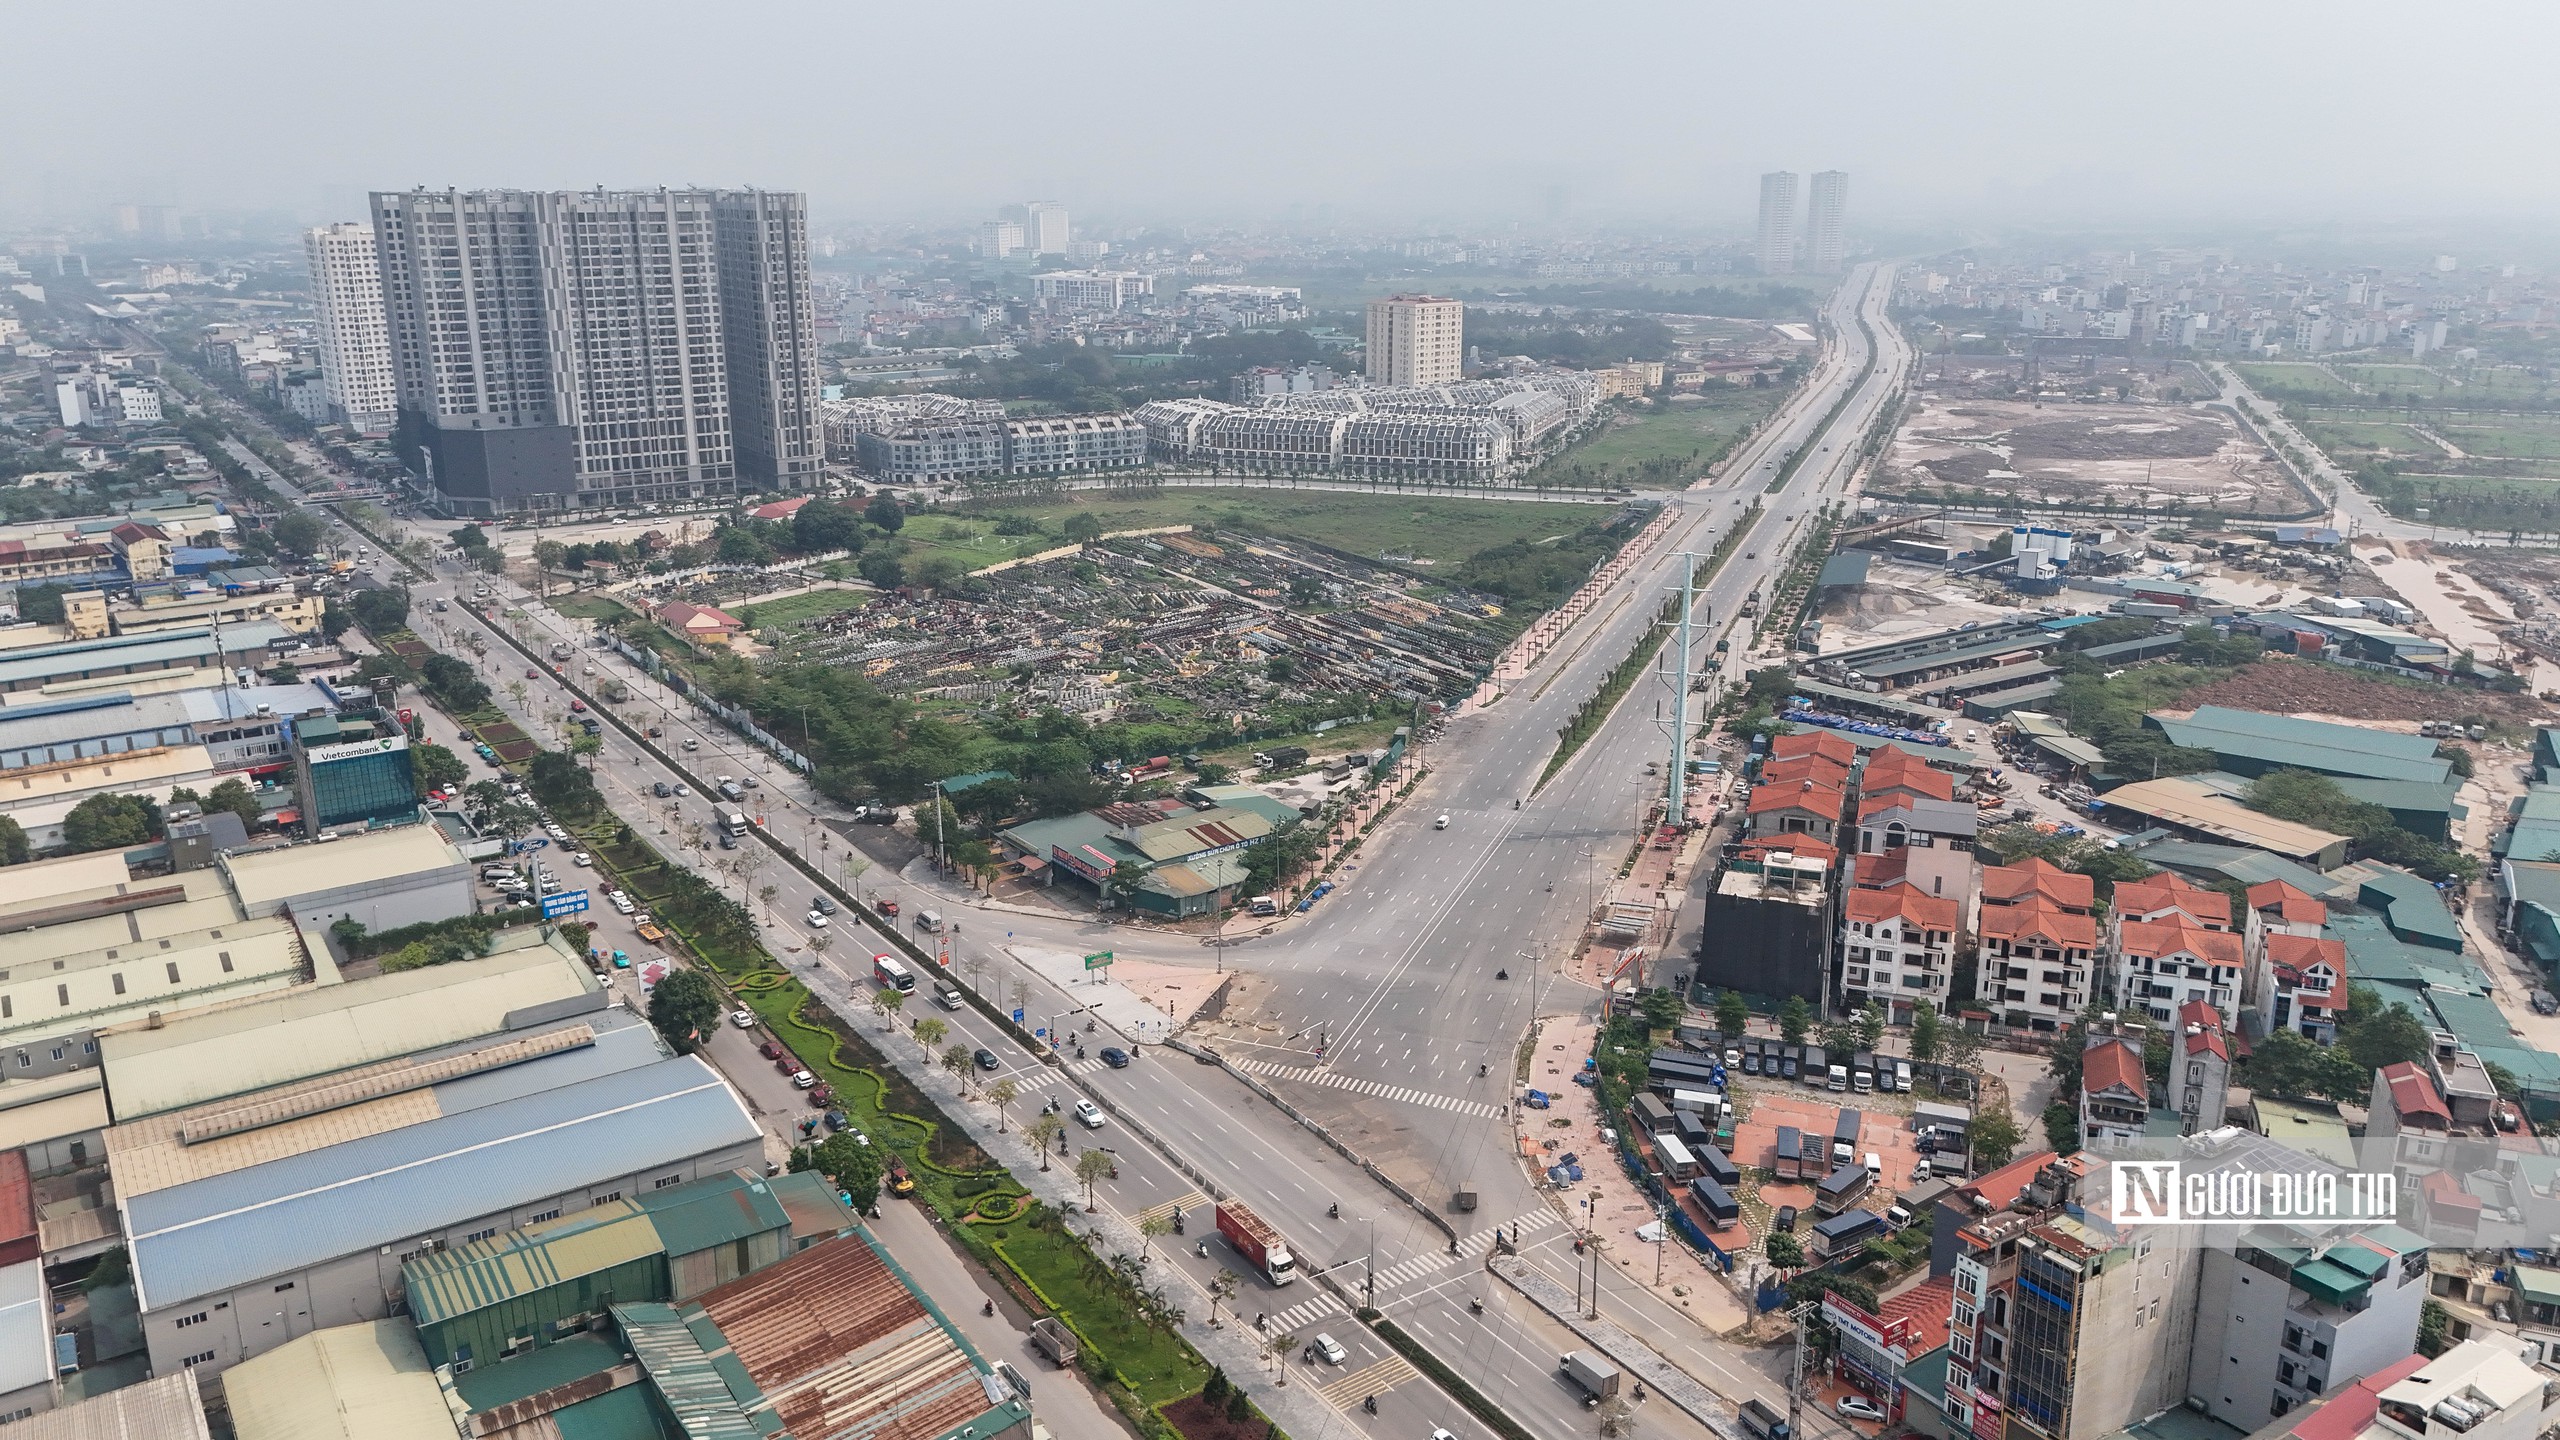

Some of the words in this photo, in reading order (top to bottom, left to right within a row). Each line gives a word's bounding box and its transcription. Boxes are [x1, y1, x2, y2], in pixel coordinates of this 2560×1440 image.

[272, 639, 298, 648] SERVICE
[321, 745, 380, 760] Vietcombank
[522, 840, 544, 851] Ford
[1249, 837, 1259, 846] HZ
[1838, 1315, 1849, 1328] TMT
[1850, 1324, 1876, 1344] MOTORS
